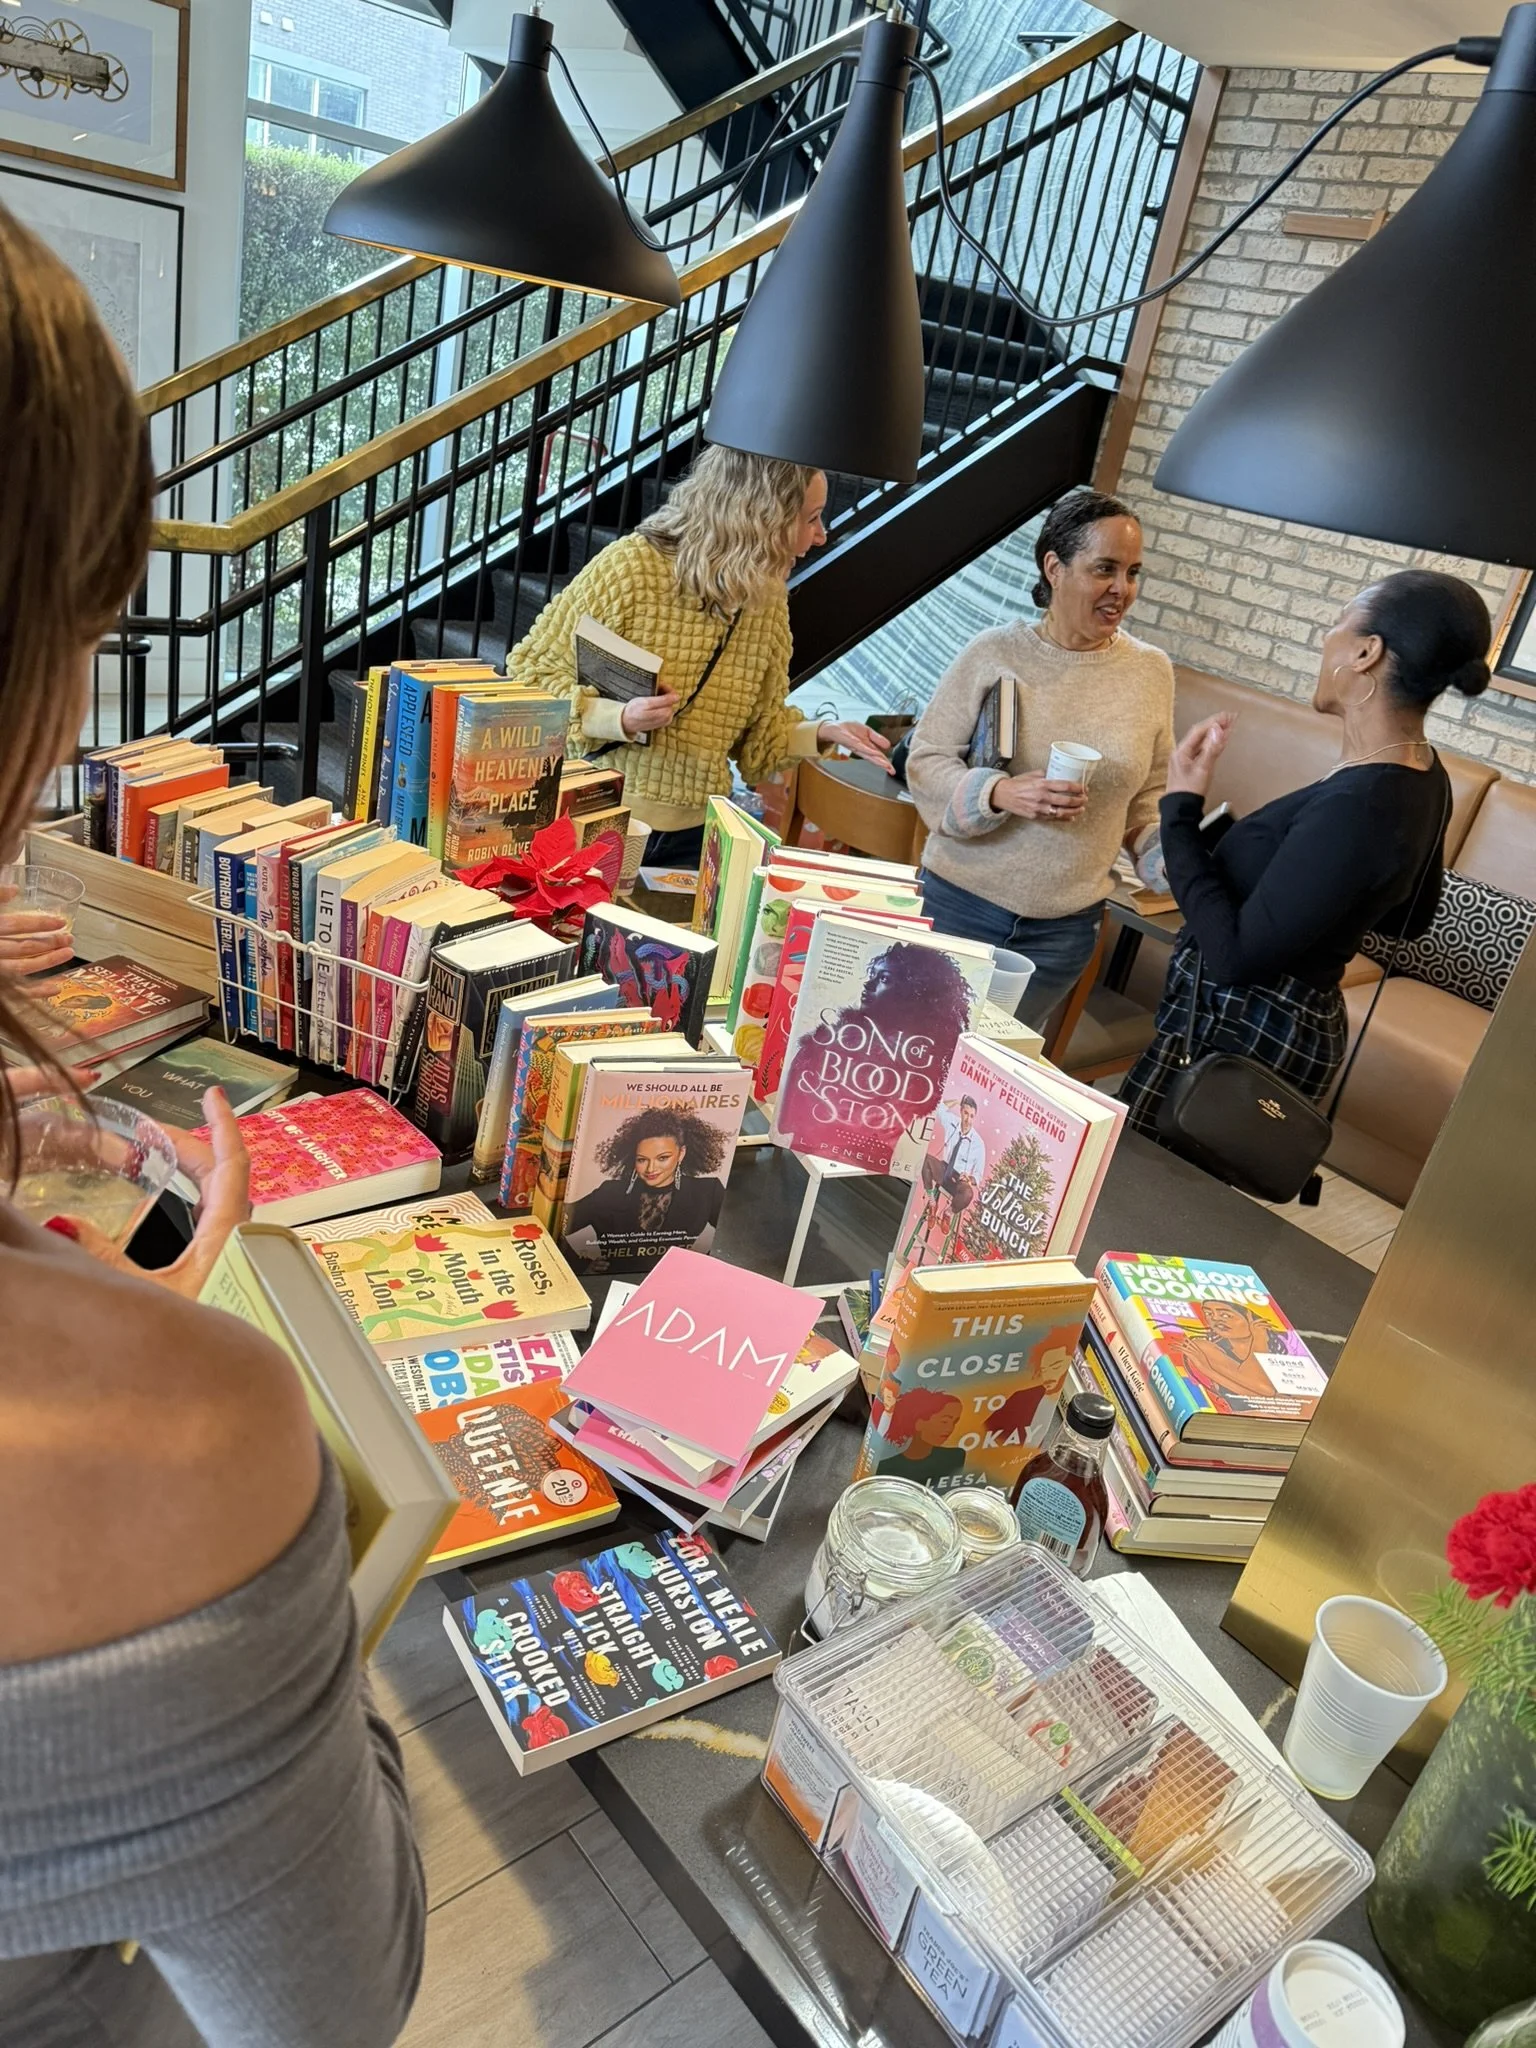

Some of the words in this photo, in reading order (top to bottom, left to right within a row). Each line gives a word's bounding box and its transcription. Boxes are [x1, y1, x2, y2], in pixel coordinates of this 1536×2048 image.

[366, 694, 374, 724] HOUSE
[400, 683, 419, 757] APPLESEED
[456, 704, 466, 747] HEAVENLY
[481, 728, 492, 751] A
[500, 725, 542, 749] WILD
[461, 731, 471, 753] WILD
[452, 749, 460, 783] PLACE
[474, 755, 561, 783] HEAVENLY
[488, 790, 539, 815] PLACE
[185, 840, 193, 855] ALL
[444, 824, 453, 861] OLIVEIRA
[450, 835, 460, 861] ROBIN
[467, 845, 499, 862] ROBIN
[217, 856, 231, 910] BOYFRIEND
[291, 865, 300, 886] YOUR
[293, 888, 301, 924] DESTINY
[319, 889, 334, 917] LIE
[261, 909, 273, 932] The
[318, 922, 332, 944] TO
[366, 923, 380, 962] Eleutheria
[385, 932, 400, 970] Wedding
[247, 964, 257, 984] LIFE
[501, 957, 543, 972] ANNIVERSARY
[544, 950, 567, 961] EDITION
[64, 967, 152, 1015] METAL
[88, 965, 171, 1006] SELF-SAME
[122, 970, 162, 990] THAT
[433, 970, 457, 998] AYN
[413, 996, 426, 1028] GILLIAN
[429, 992, 456, 1019] RAND
[406, 1029, 415, 1050] FLYNN
[810, 1007, 936, 1070] SONG
[910, 1043, 929, 1057] OF
[120, 1082, 153, 1099] YOU
[161, 1070, 206, 1091] WHAT
[415, 1047, 434, 1129] SHRUGGED
[430, 1055, 450, 1104] ATLAS
[626, 1083, 645, 1093] WE
[645, 1083, 688, 1093] SHOULD
[689, 1083, 709, 1093] ALL
[710, 1083, 723, 1093] BE
[819, 1050, 934, 1106] BLOOD
[963, 1053, 977, 1065] NEW
[976, 1061, 992, 1074] YORK
[992, 1070, 1009, 1090] TIMES
[1008, 1083, 1046, 1113] BESTSELLING
[1045, 1108, 1068, 1129] AUTHOR
[362, 1093, 388, 1114] NOVEL
[600, 1094, 741, 1110] MILLIONAIRES
[812, 1084, 936, 1145] STONE
[959, 1060, 996, 1094] DANNY
[999, 1086, 1067, 1144] PELLEGRINO
[1257, 1098, 1287, 1121] COACH
[262, 1110, 288, 1125] CITY
[283, 1125, 302, 1136] OF
[296, 1136, 348, 1181] LAUGHTER
[820, 1142, 912, 1173] PENELOPE
[1006, 1174, 1035, 1201] THE
[980, 1181, 1043, 1236] Jolliest
[585, 1239, 607, 1247] Building
[639, 1237, 658, 1245] Gaining
[658, 1235, 683, 1243] Economic
[607, 1231, 630, 1239] Woman's
[630, 1230, 646, 1238] Guide
[653, 1230, 672, 1238] Earning
[980, 1209, 1031, 1258] BUNCH
[322, 1250, 343, 1288] Bushra
[477, 1247, 503, 1267] in
[511, 1238, 554, 1297] Roses,
[364, 1269, 398, 1310] Lion
[406, 1267, 437, 1285] of
[439, 1252, 485, 1305] Mouth
[489, 1270, 516, 1297] the
[1118, 1262, 1187, 1283] EVERY
[1191, 1269, 1257, 1291] BODY
[415, 1289, 436, 1301] a
[1126, 1275, 1270, 1307] LOOKING
[1147, 1297, 1192, 1309] CANDICE
[1149, 1303, 1196, 1319] ILOH
[951, 1313, 1025, 1338] THIS
[615, 1298, 789, 1388] ADAM
[916, 1351, 1024, 1379] CLOSE
[1117, 1345, 1133, 1374] When
[1128, 1365, 1146, 1394] Katie
[1267, 1357, 1306, 1368] Signed
[1142, 1351, 1175, 1411] LOOKING
[971, 1394, 1007, 1413] TO
[957, 1424, 1044, 1451] OKAY
[456, 1404, 542, 1527] QUEENIE
[925, 1471, 988, 1490] LEESA
[653, 1555, 728, 1652] HURSTON
[668, 1536, 719, 1586] ZORA
[705, 1586, 769, 1657] NEALE
[538, 1603, 553, 1625] HARLEM
[640, 1611, 653, 1622] A
[643, 1590, 677, 1632] HITTING
[575, 1611, 620, 1657] LICK
[592, 1581, 662, 1670] STRAIGHT
[551, 1644, 566, 1654] A
[561, 1628, 586, 1659] WITH
[478, 1638, 531, 1704] STICK
[503, 1611, 571, 1708] CROOKED
[683, 1668, 694, 1681] GOD
[625, 1682, 640, 1701] JONES
[917, 1932, 968, 1999] GREEN
[922, 1959, 951, 2001] TEA
